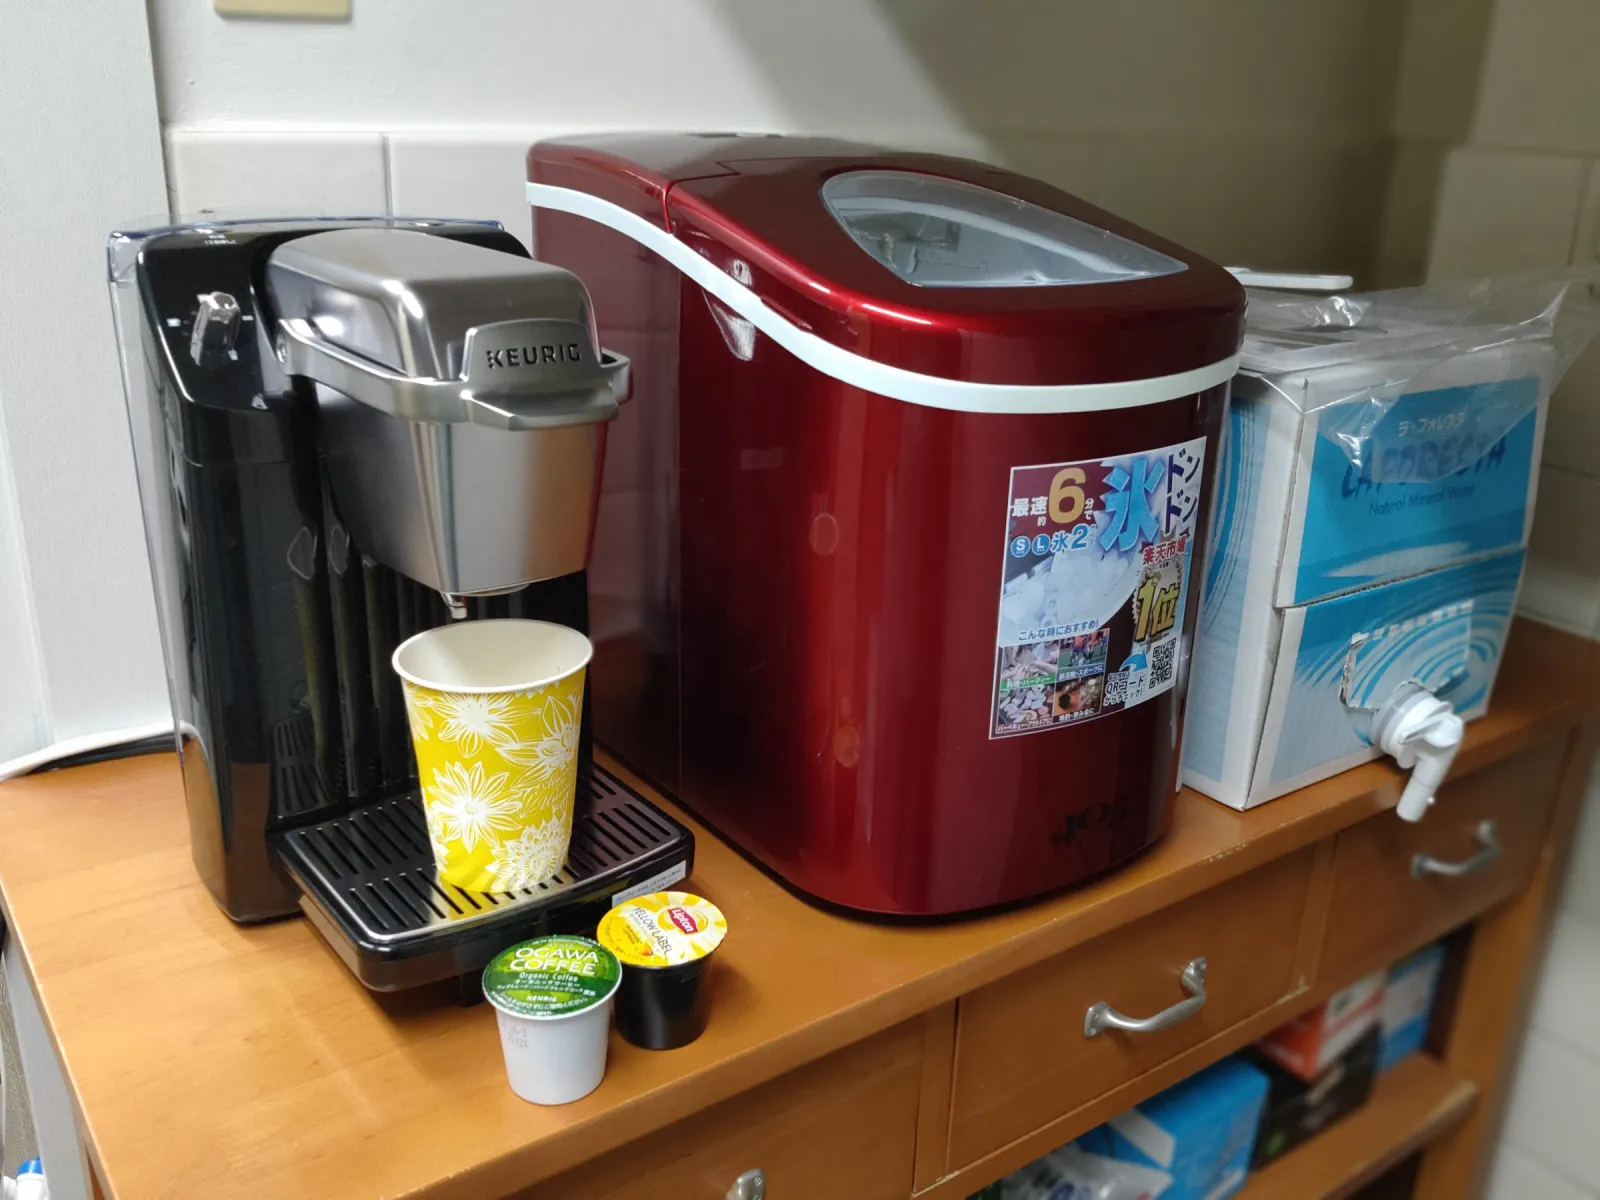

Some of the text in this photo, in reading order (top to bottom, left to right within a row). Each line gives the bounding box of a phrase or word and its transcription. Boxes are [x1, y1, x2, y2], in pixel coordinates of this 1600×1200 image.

[486, 343, 582, 369] KEURIG
[1048, 467, 1086, 524] 6
[1100, 458, 1166, 552] 氷
[1368, 494, 1406, 517] Natural
[1408, 487, 1445, 508] Mineral
[1143, 534, 1187, 566] 楽天市場
[633, 907, 656, 934] YELLOW
[651, 930, 673, 957] LABEL
[671, 908, 695, 933] Lipton
[509, 957, 597, 976] COFFEE
[515, 947, 599, 963] OGAWA
[519, 971, 579, 983] Organic Coffee
